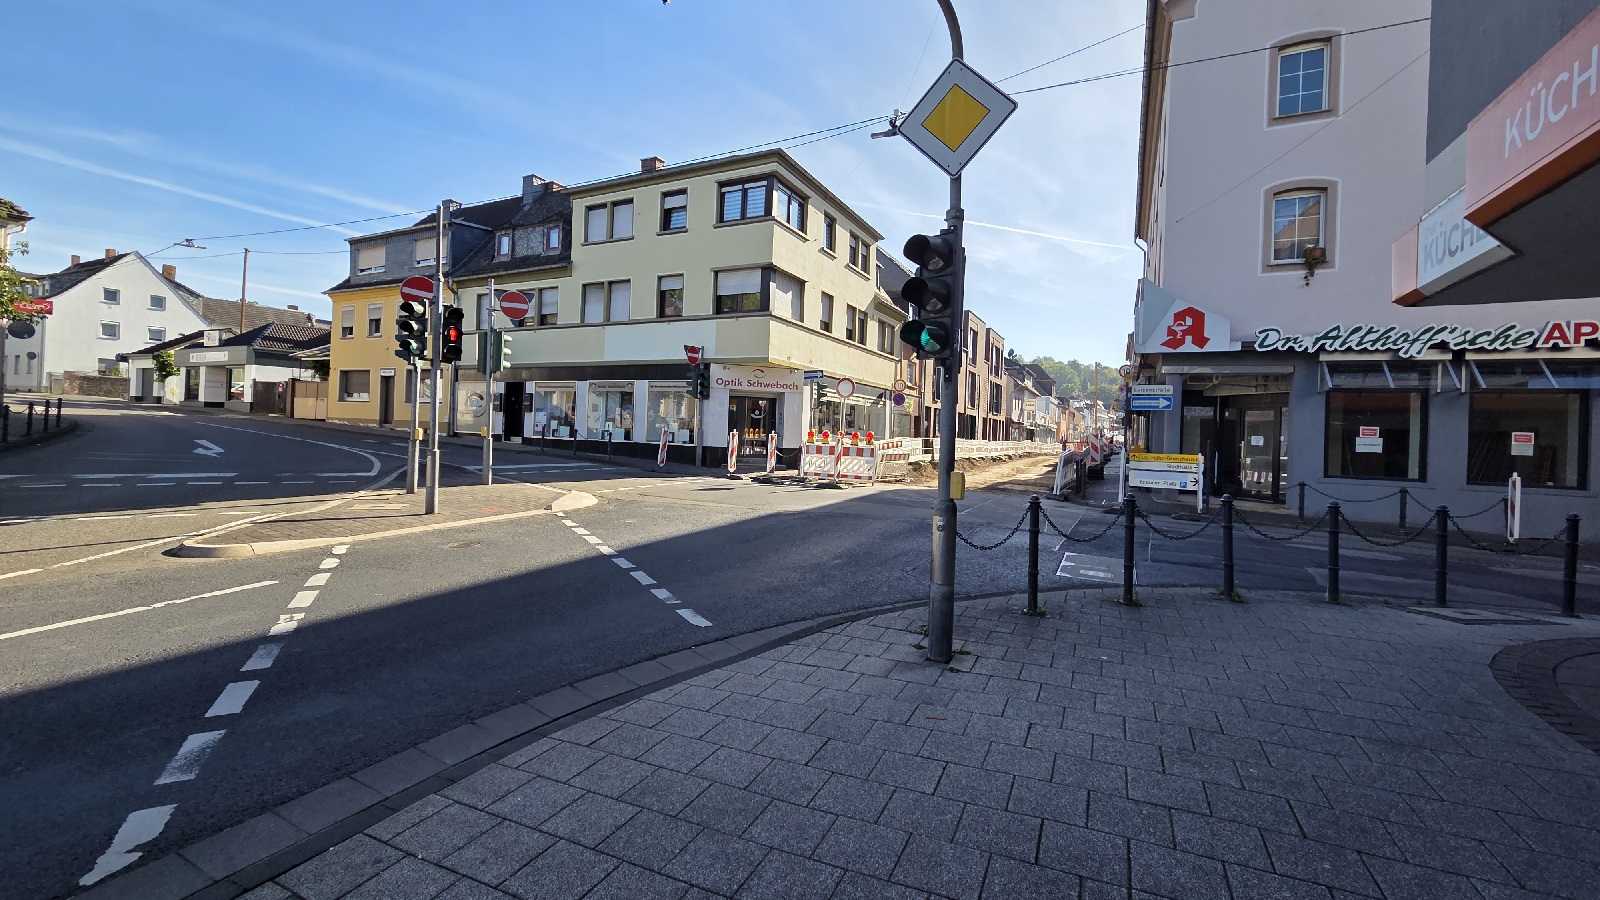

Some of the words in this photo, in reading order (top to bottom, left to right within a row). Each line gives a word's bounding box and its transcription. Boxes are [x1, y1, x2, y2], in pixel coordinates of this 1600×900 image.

[1257, 327, 1305, 350] Dr.
[1311, 323, 1536, 356] Althoff'sche
[1122, 367, 1131, 375] 10
[716, 377, 743, 388] Optik
[746, 379, 799, 391] Schwebach
[1166, 463, 1193, 471] Stadthalle
